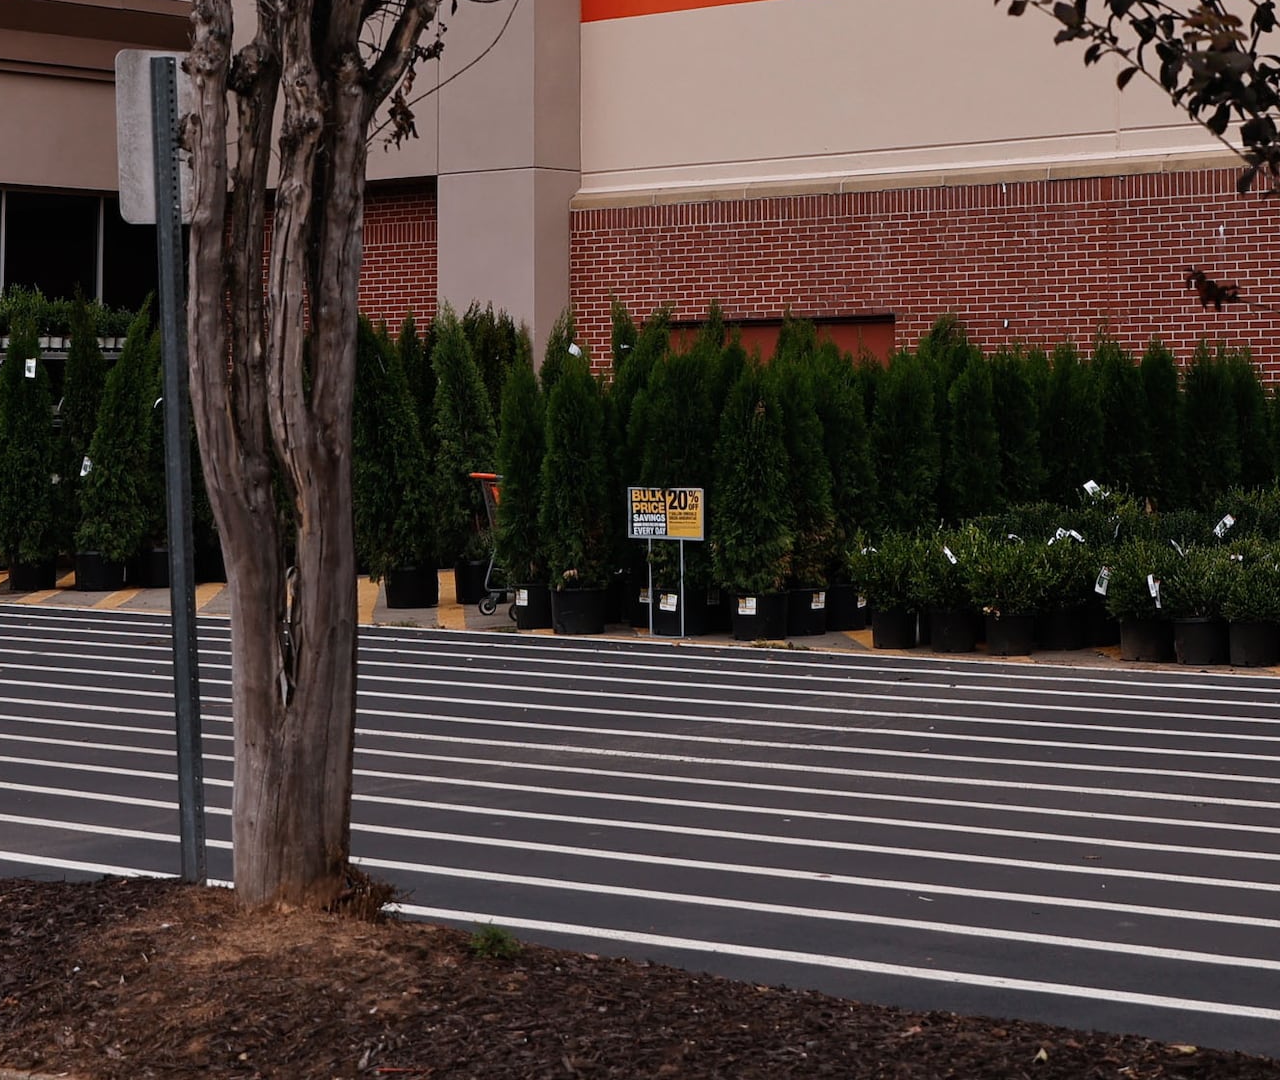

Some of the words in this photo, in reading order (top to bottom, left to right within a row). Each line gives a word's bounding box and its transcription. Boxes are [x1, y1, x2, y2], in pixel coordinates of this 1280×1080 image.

[632, 489, 665, 501] BULK
[632, 502, 665, 513] PRICE
[633, 514, 666, 522] SAVINGS
[633, 527, 654, 536] EVERY
[655, 527, 667, 536] DAY
